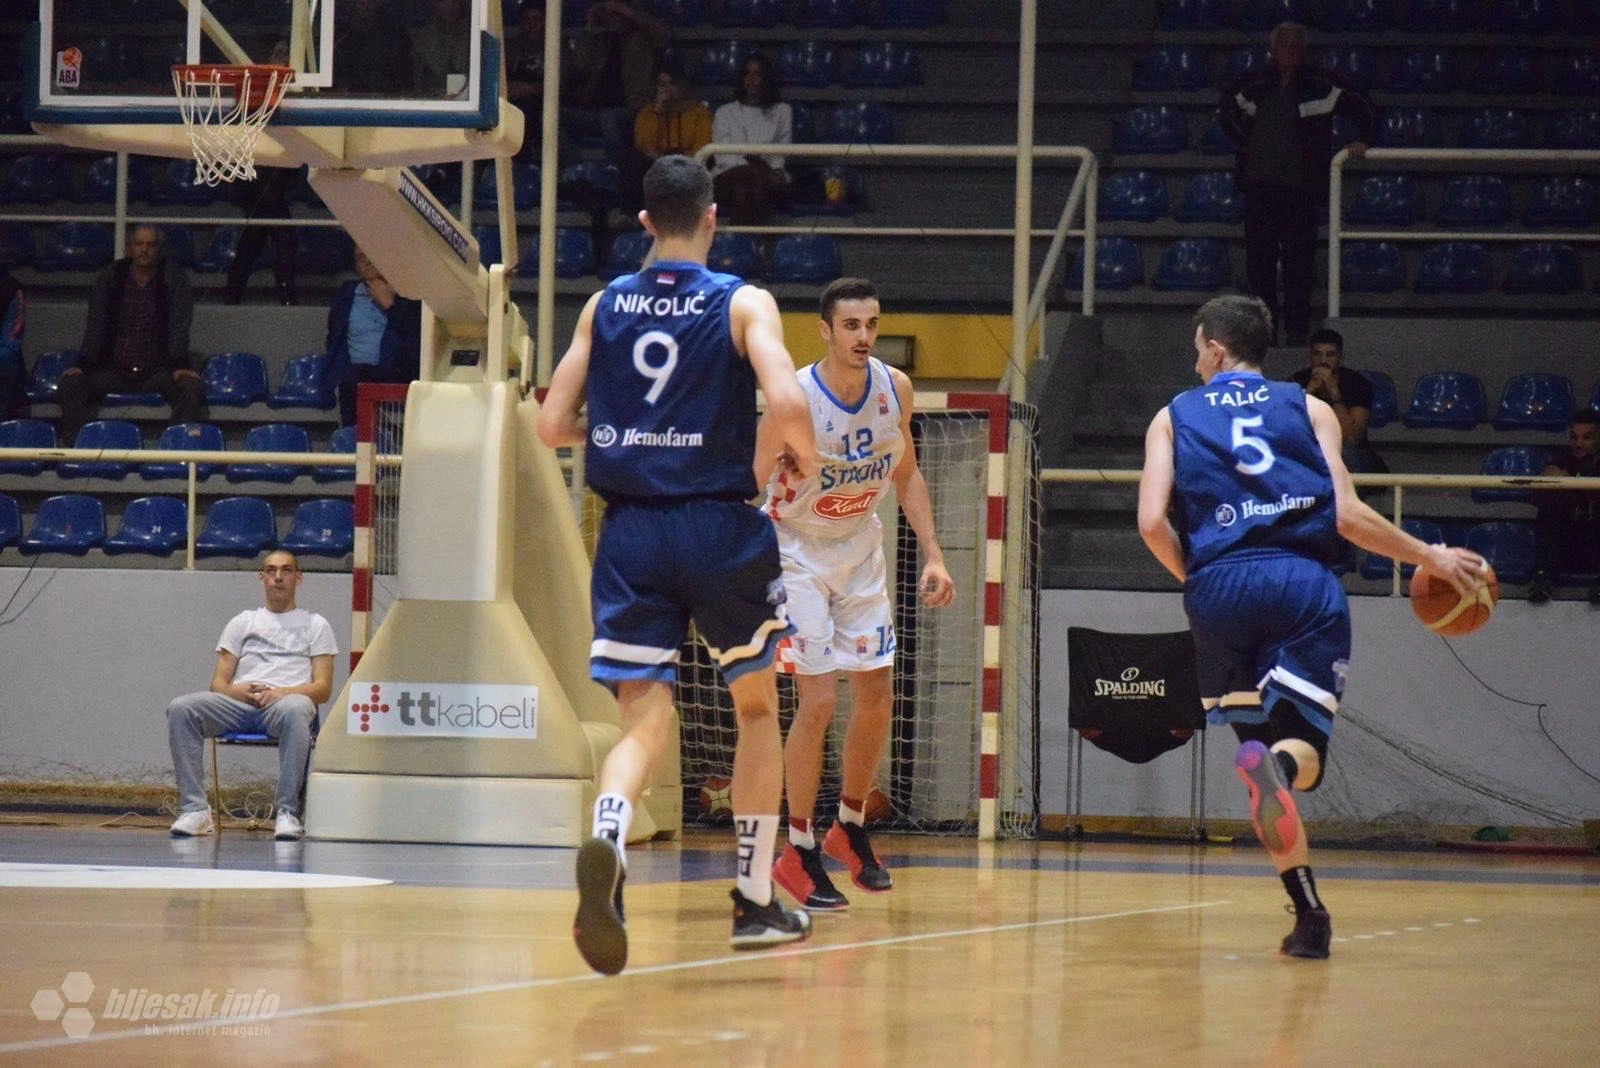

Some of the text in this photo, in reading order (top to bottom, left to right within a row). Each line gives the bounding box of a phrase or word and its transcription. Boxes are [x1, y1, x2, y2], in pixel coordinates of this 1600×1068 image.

[59, 69, 77, 84] ABA
[613, 291, 706, 317] NIKOLIĆ
[632, 331, 679, 405] 9
[1205, 385, 1270, 407] TALIĆ
[621, 426, 703, 448] Hemofarm
[841, 427, 874, 462] 12
[1231, 415, 1276, 476] 5
[1241, 493, 1316, 519] Hemofarm
[1094, 678, 1166, 697] SPALDING
